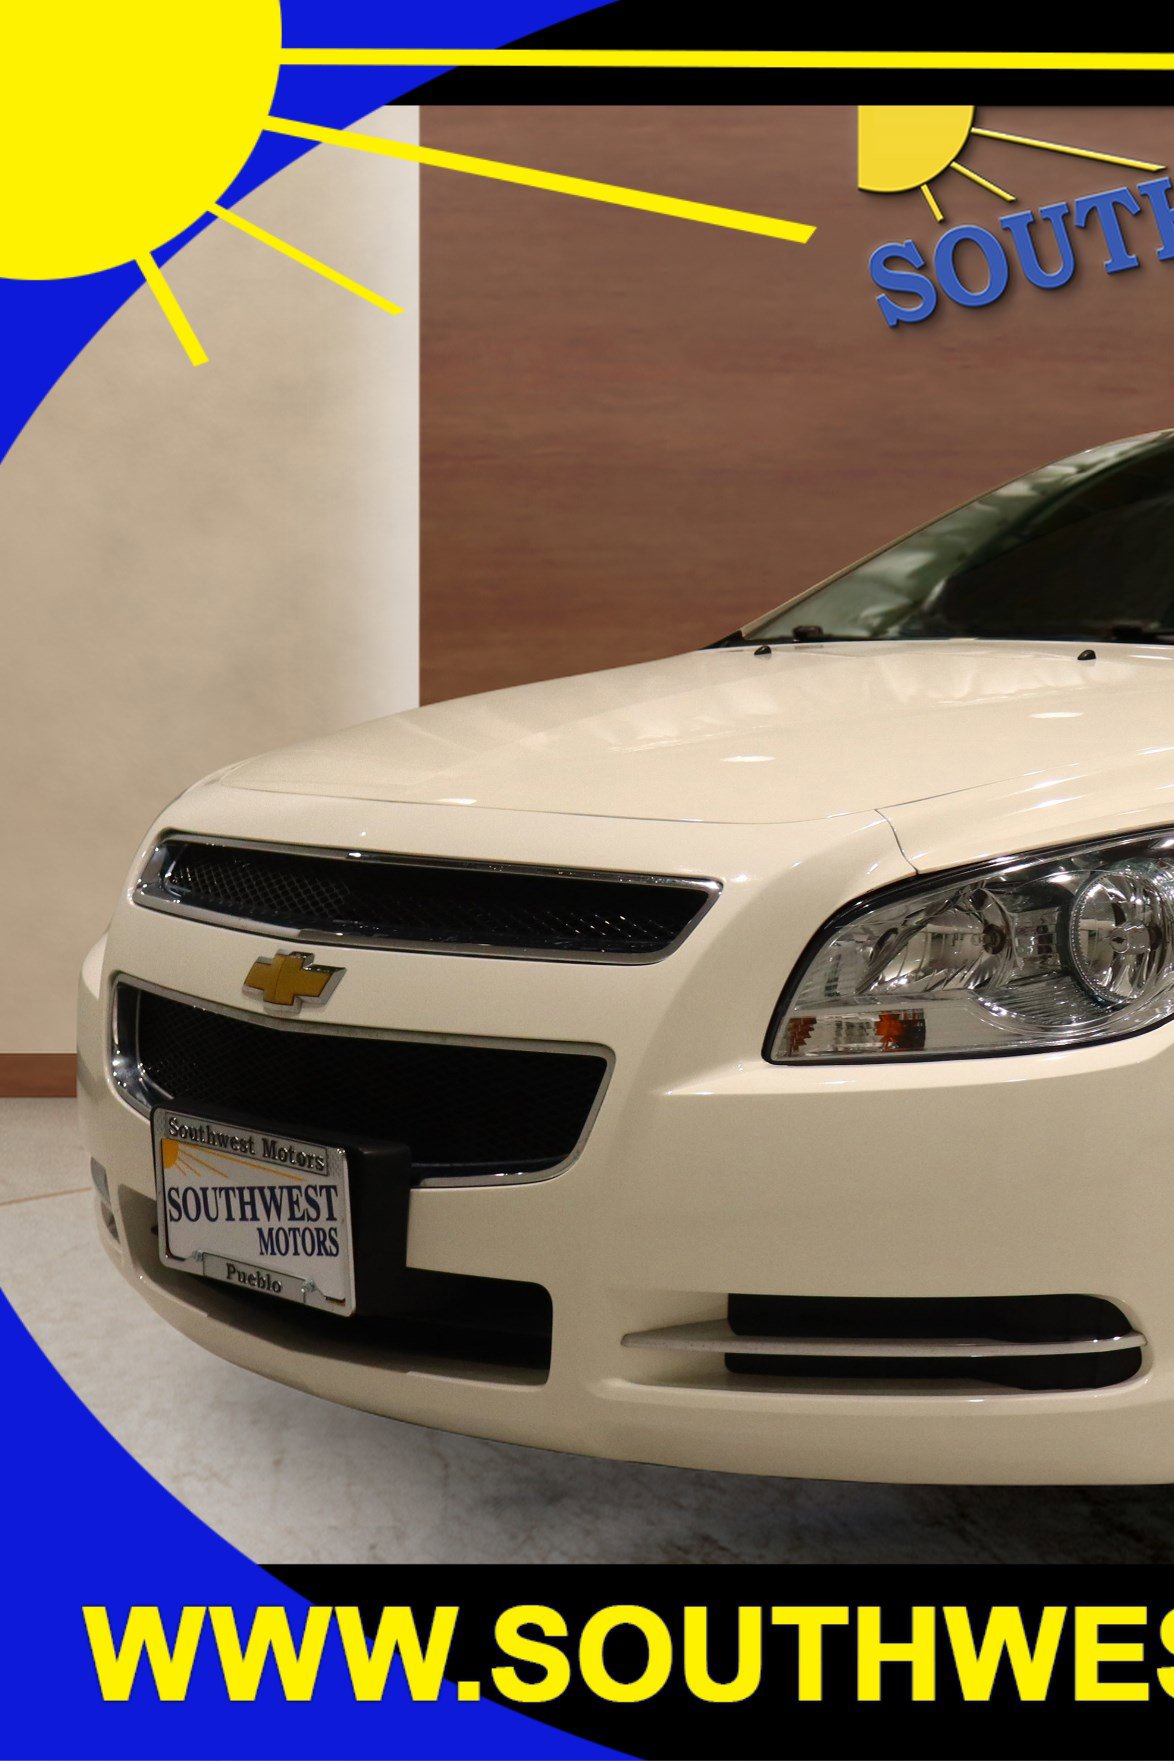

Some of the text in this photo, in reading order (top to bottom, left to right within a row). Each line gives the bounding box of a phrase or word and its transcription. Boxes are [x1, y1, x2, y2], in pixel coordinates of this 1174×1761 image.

[168, 1117, 325, 1171] Southwest Motors
[167, 1184, 338, 1222] SOUTHWEST
[257, 1227, 340, 1257] MOTORS
[226, 1263, 282, 1293] Pueblo
